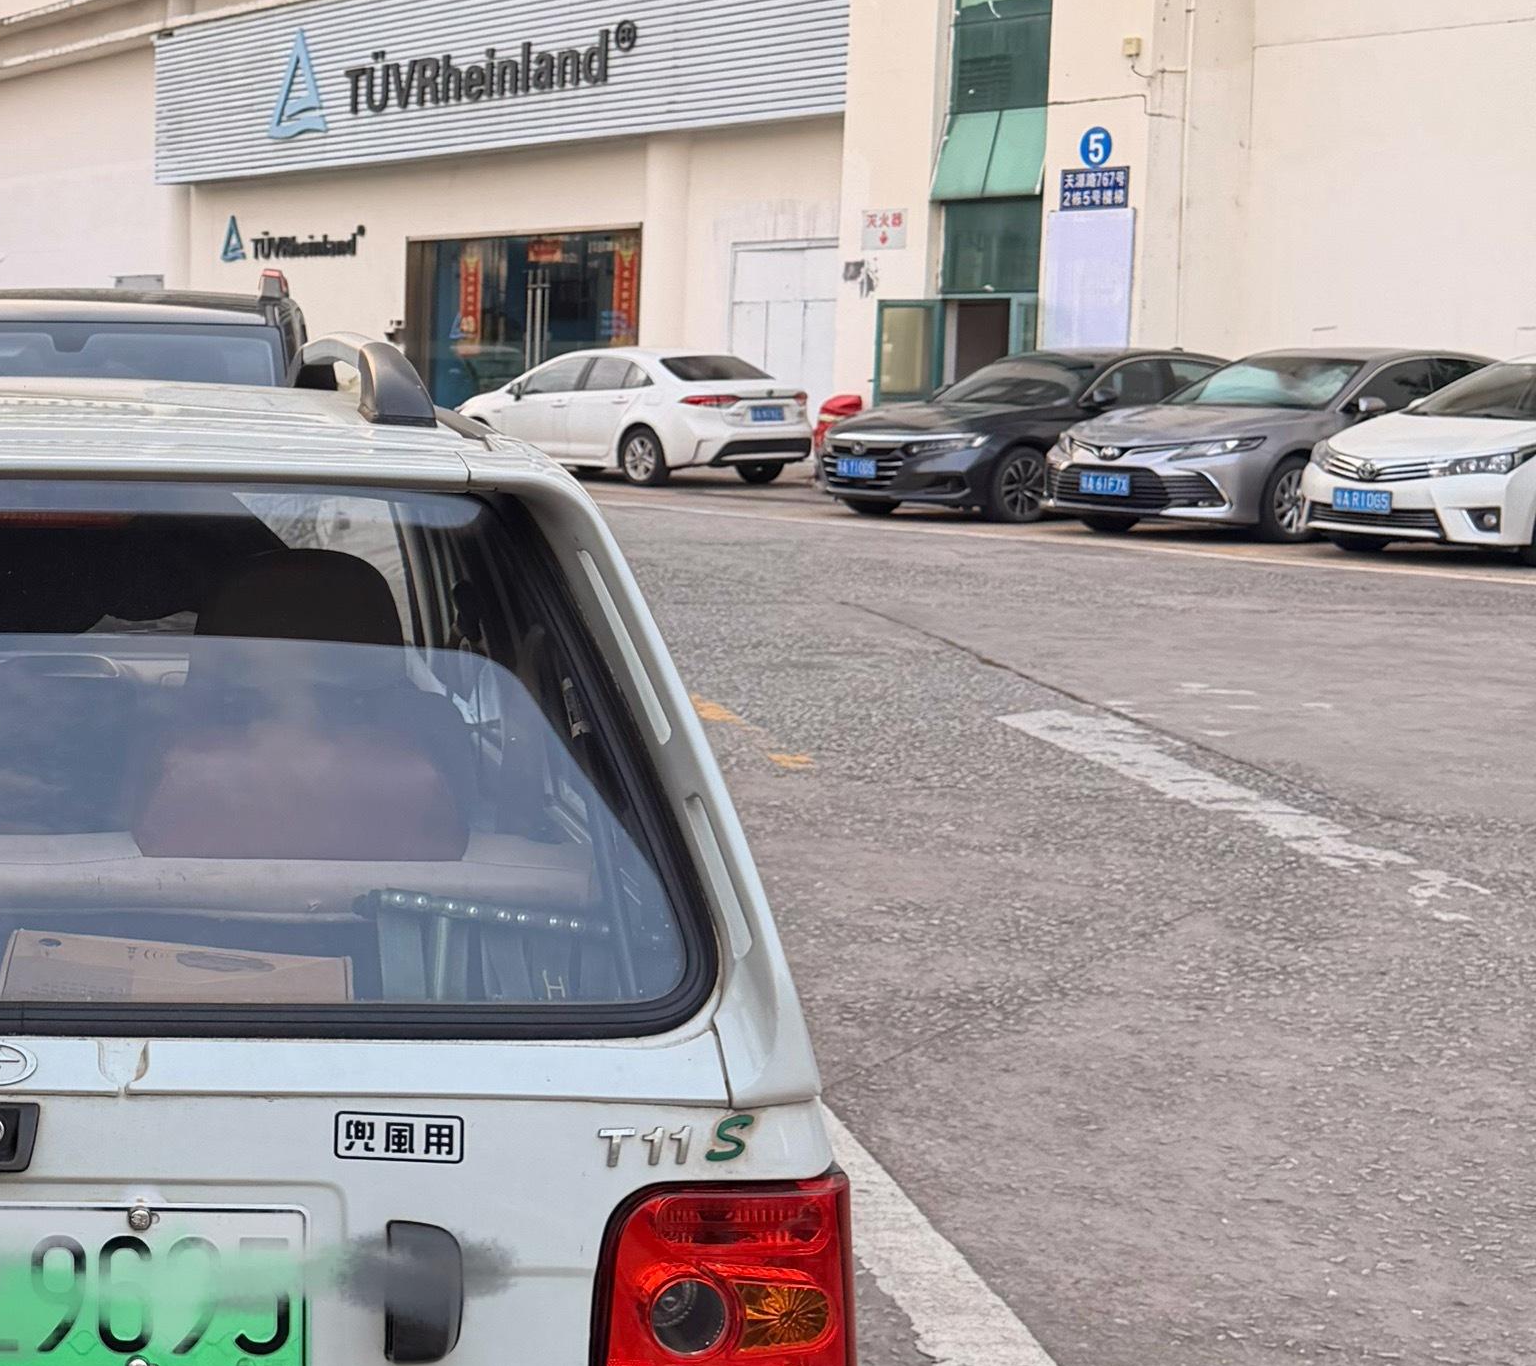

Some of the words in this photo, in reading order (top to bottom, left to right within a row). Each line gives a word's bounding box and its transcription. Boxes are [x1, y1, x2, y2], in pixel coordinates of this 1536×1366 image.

[1088, 133, 1105, 163] 5
[866, 212, 902, 228] 灭火器
[344, 1119, 454, 1155] 兜風用
